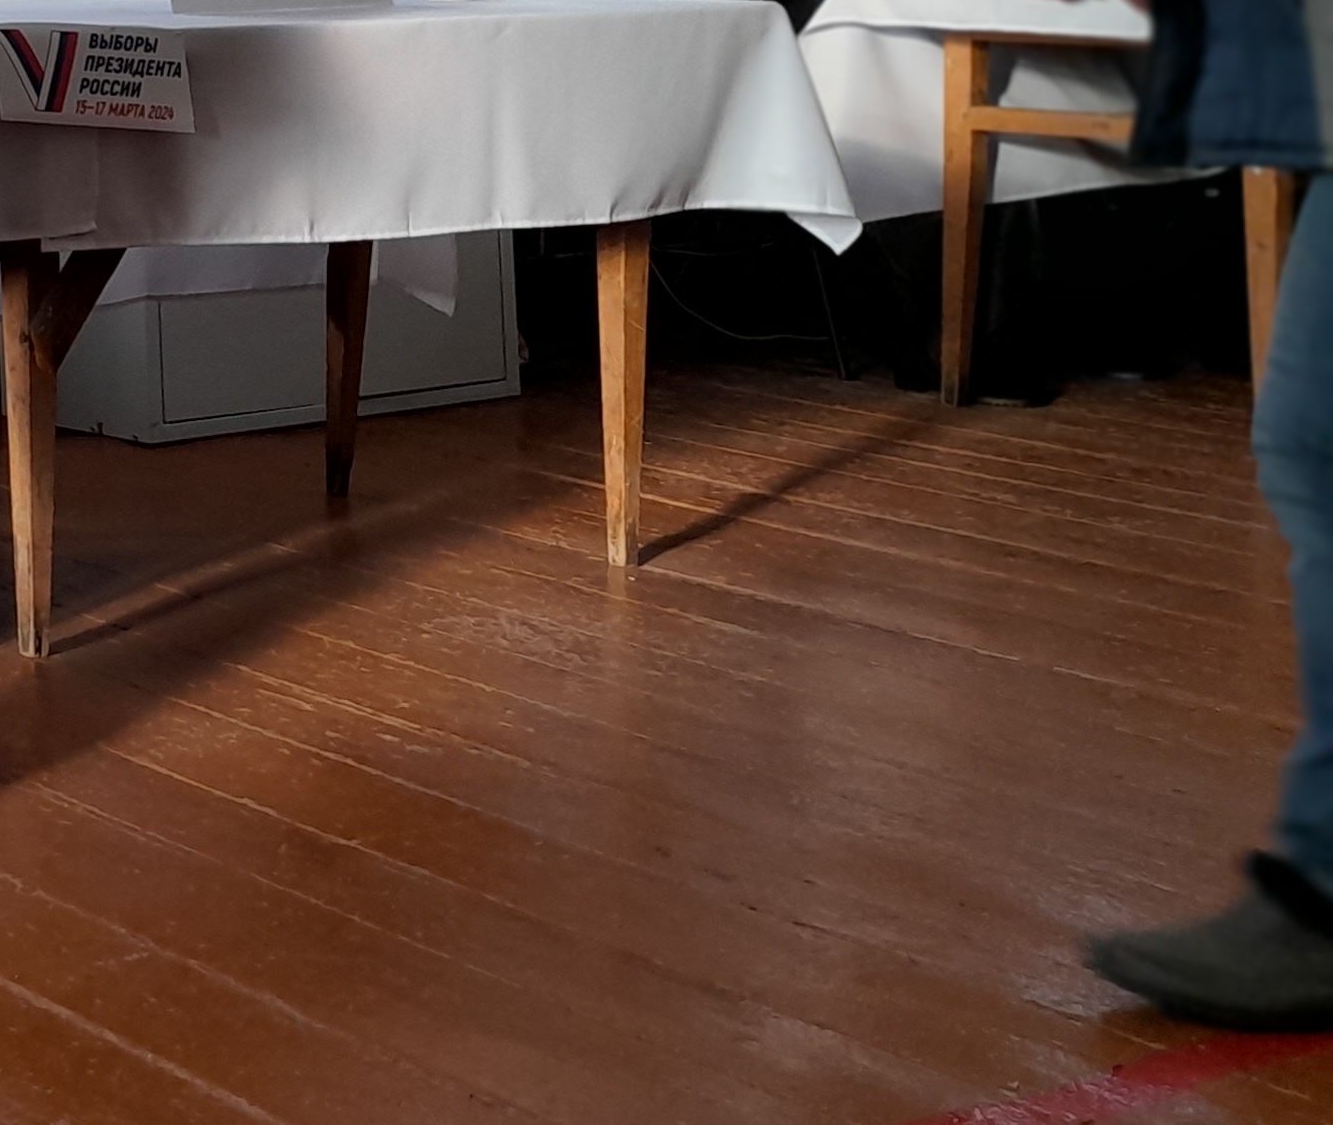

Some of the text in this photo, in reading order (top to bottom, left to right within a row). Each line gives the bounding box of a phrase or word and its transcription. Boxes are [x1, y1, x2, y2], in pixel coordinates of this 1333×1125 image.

[88, 33, 158, 53] ВЫБОРЫ
[84, 55, 181, 78] ПРЕЗИДЕНТА
[79, 78, 142, 98] РОССИИ
[108, 102, 145, 119] МАРТА
[147, 104, 174, 120] 2024
